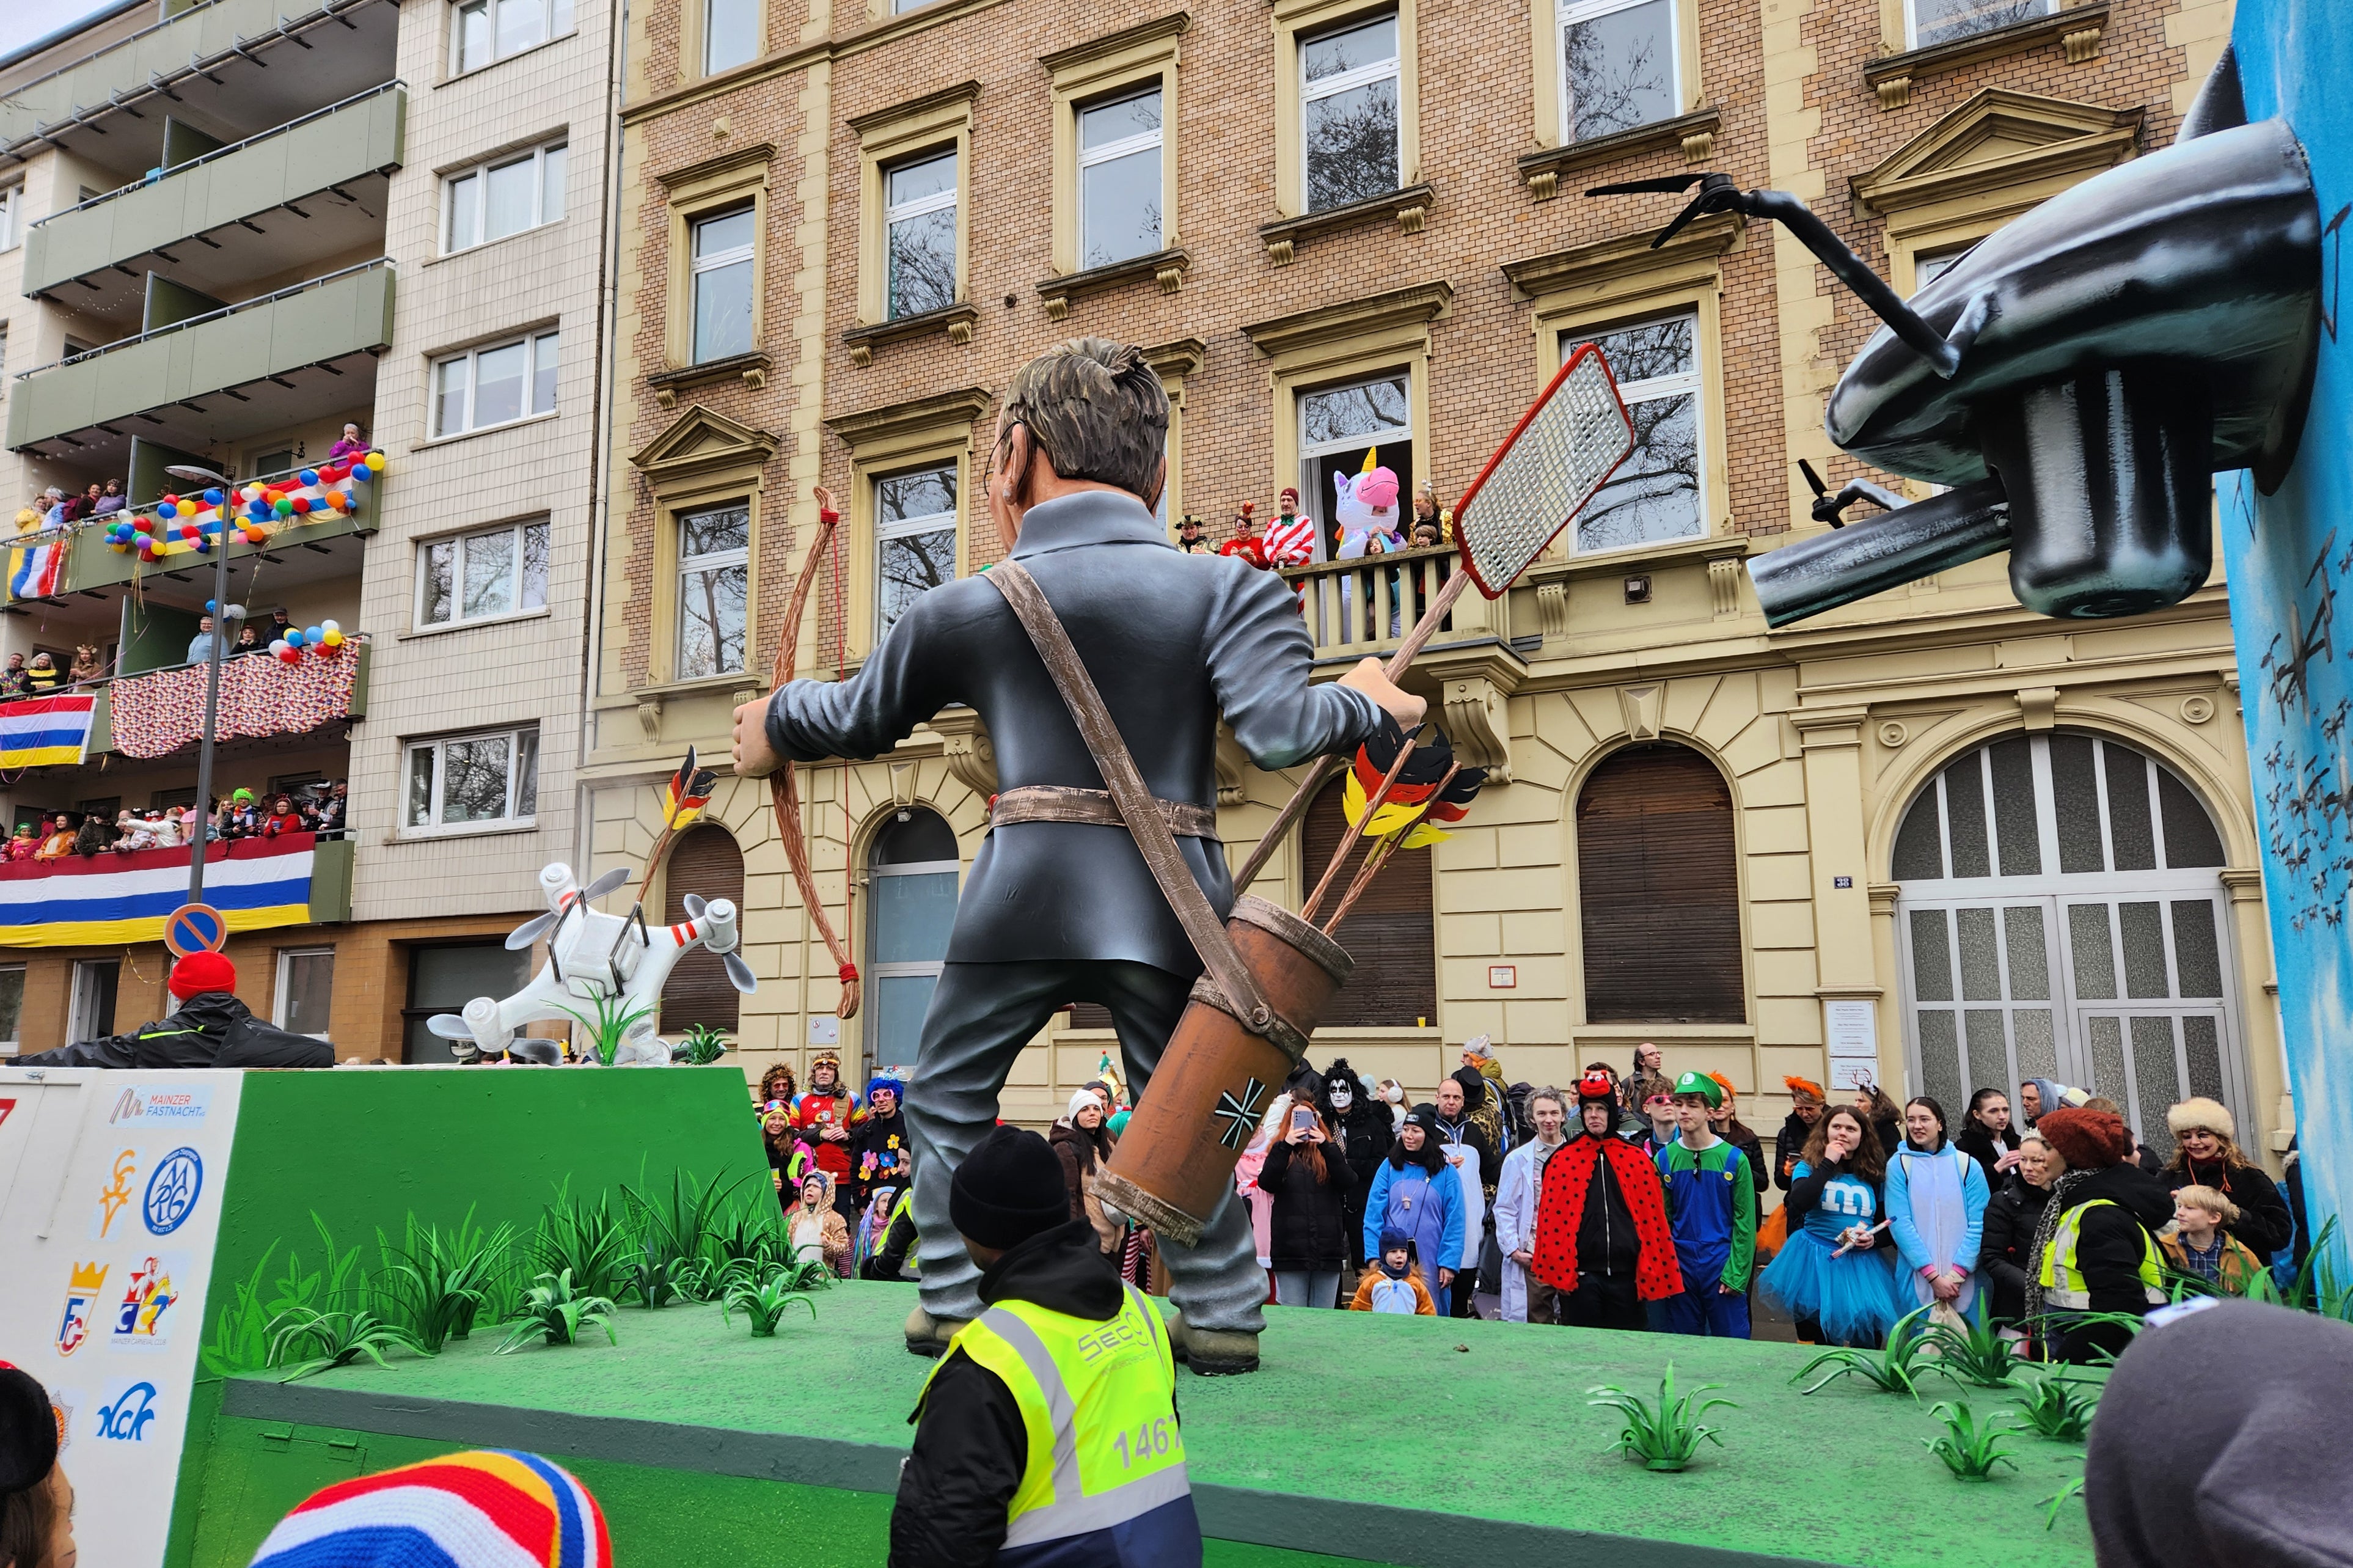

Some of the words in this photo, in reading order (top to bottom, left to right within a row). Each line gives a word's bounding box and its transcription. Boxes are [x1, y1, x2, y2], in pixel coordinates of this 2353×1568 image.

[1836, 877, 1850, 888] 38
[150, 1094, 191, 1105] MAINZER
[146, 1106, 202, 1116] FASTNACHT
